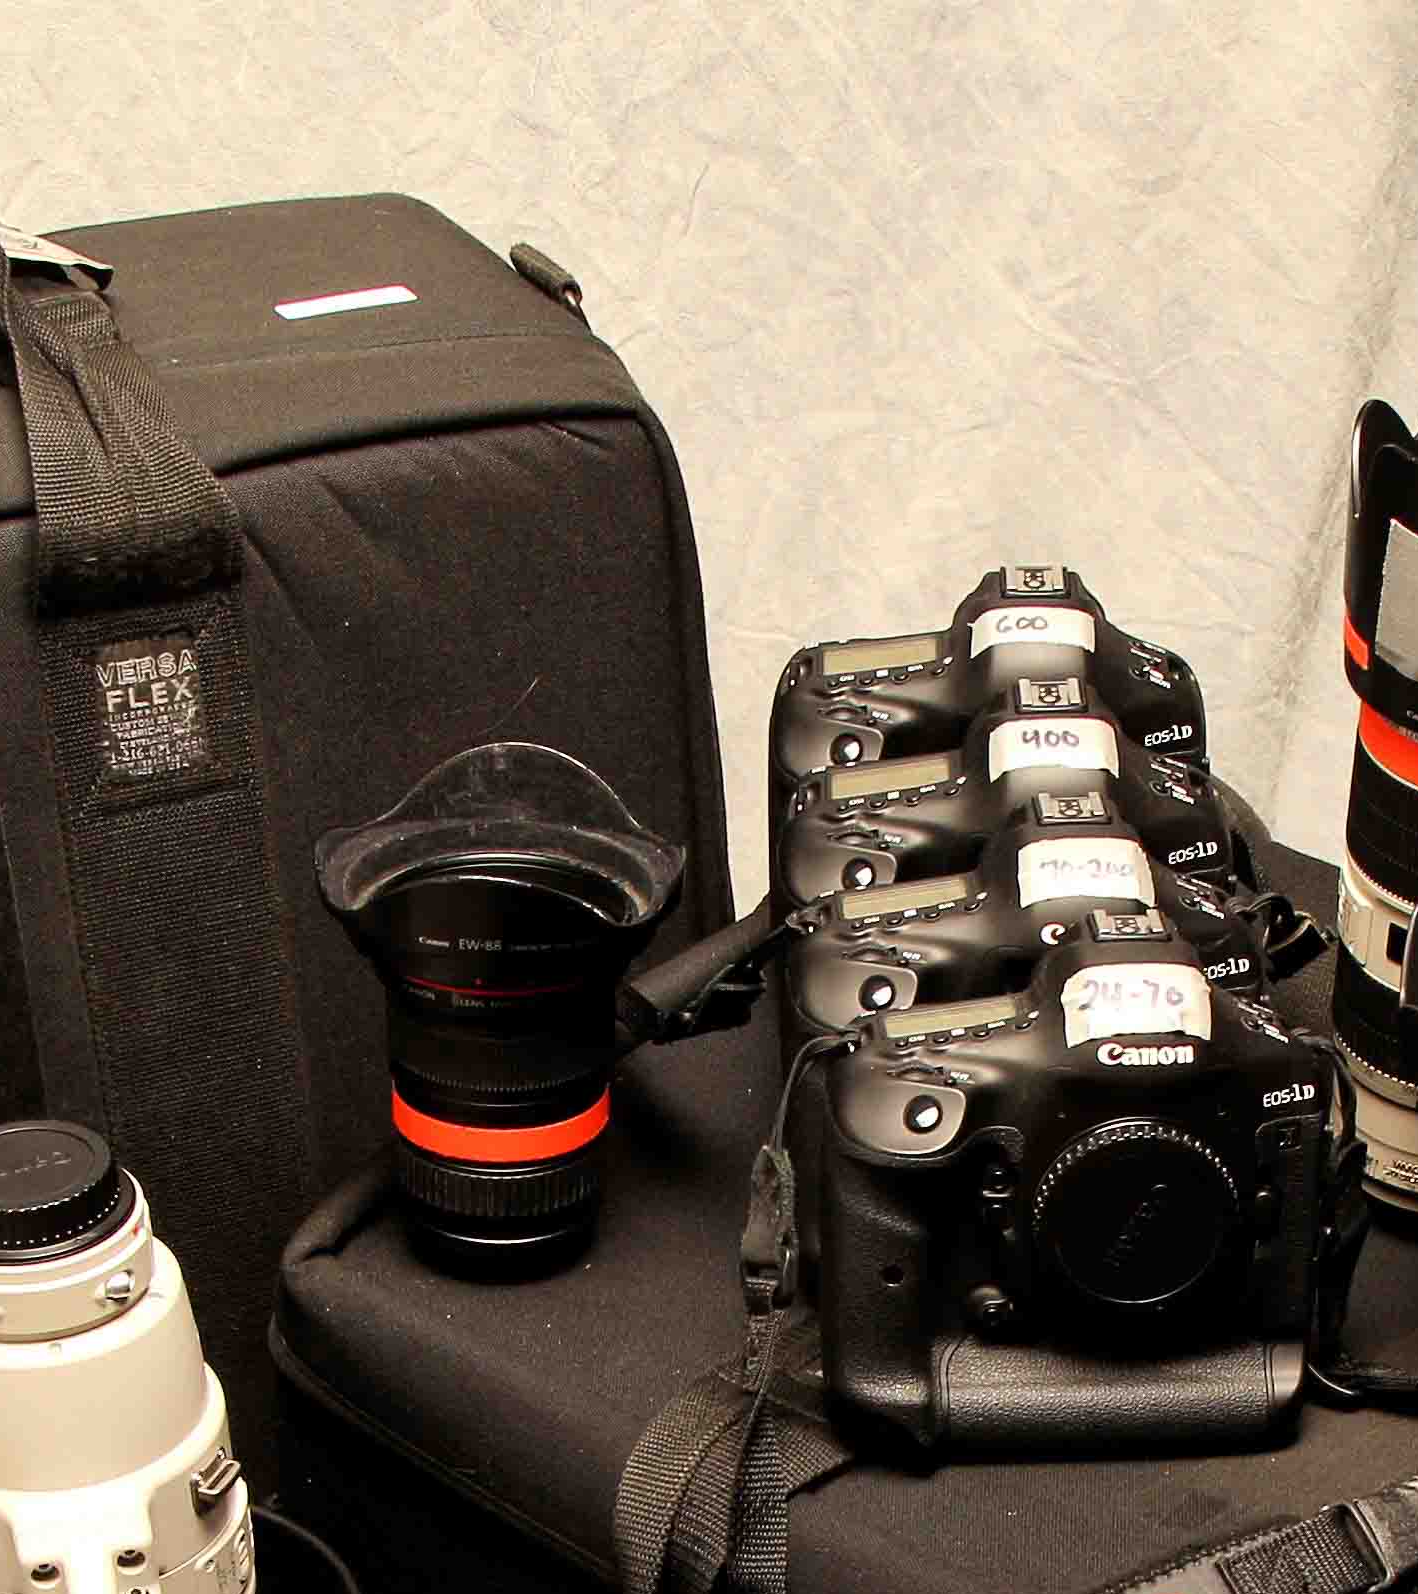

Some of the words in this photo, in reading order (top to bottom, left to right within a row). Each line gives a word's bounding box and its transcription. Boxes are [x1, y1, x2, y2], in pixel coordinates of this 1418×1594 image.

[996, 615, 1048, 632] 600
[95, 649, 197, 687] VERSA
[105, 677, 195, 713] FLEX
[1021, 729, 1080, 749] 400
[1144, 724, 1194, 747] EOS-1D
[1168, 840, 1219, 865] EOS-1D
[1096, 1041, 1195, 1066] Canon
[1262, 1083, 1316, 1108] EOS-1D
